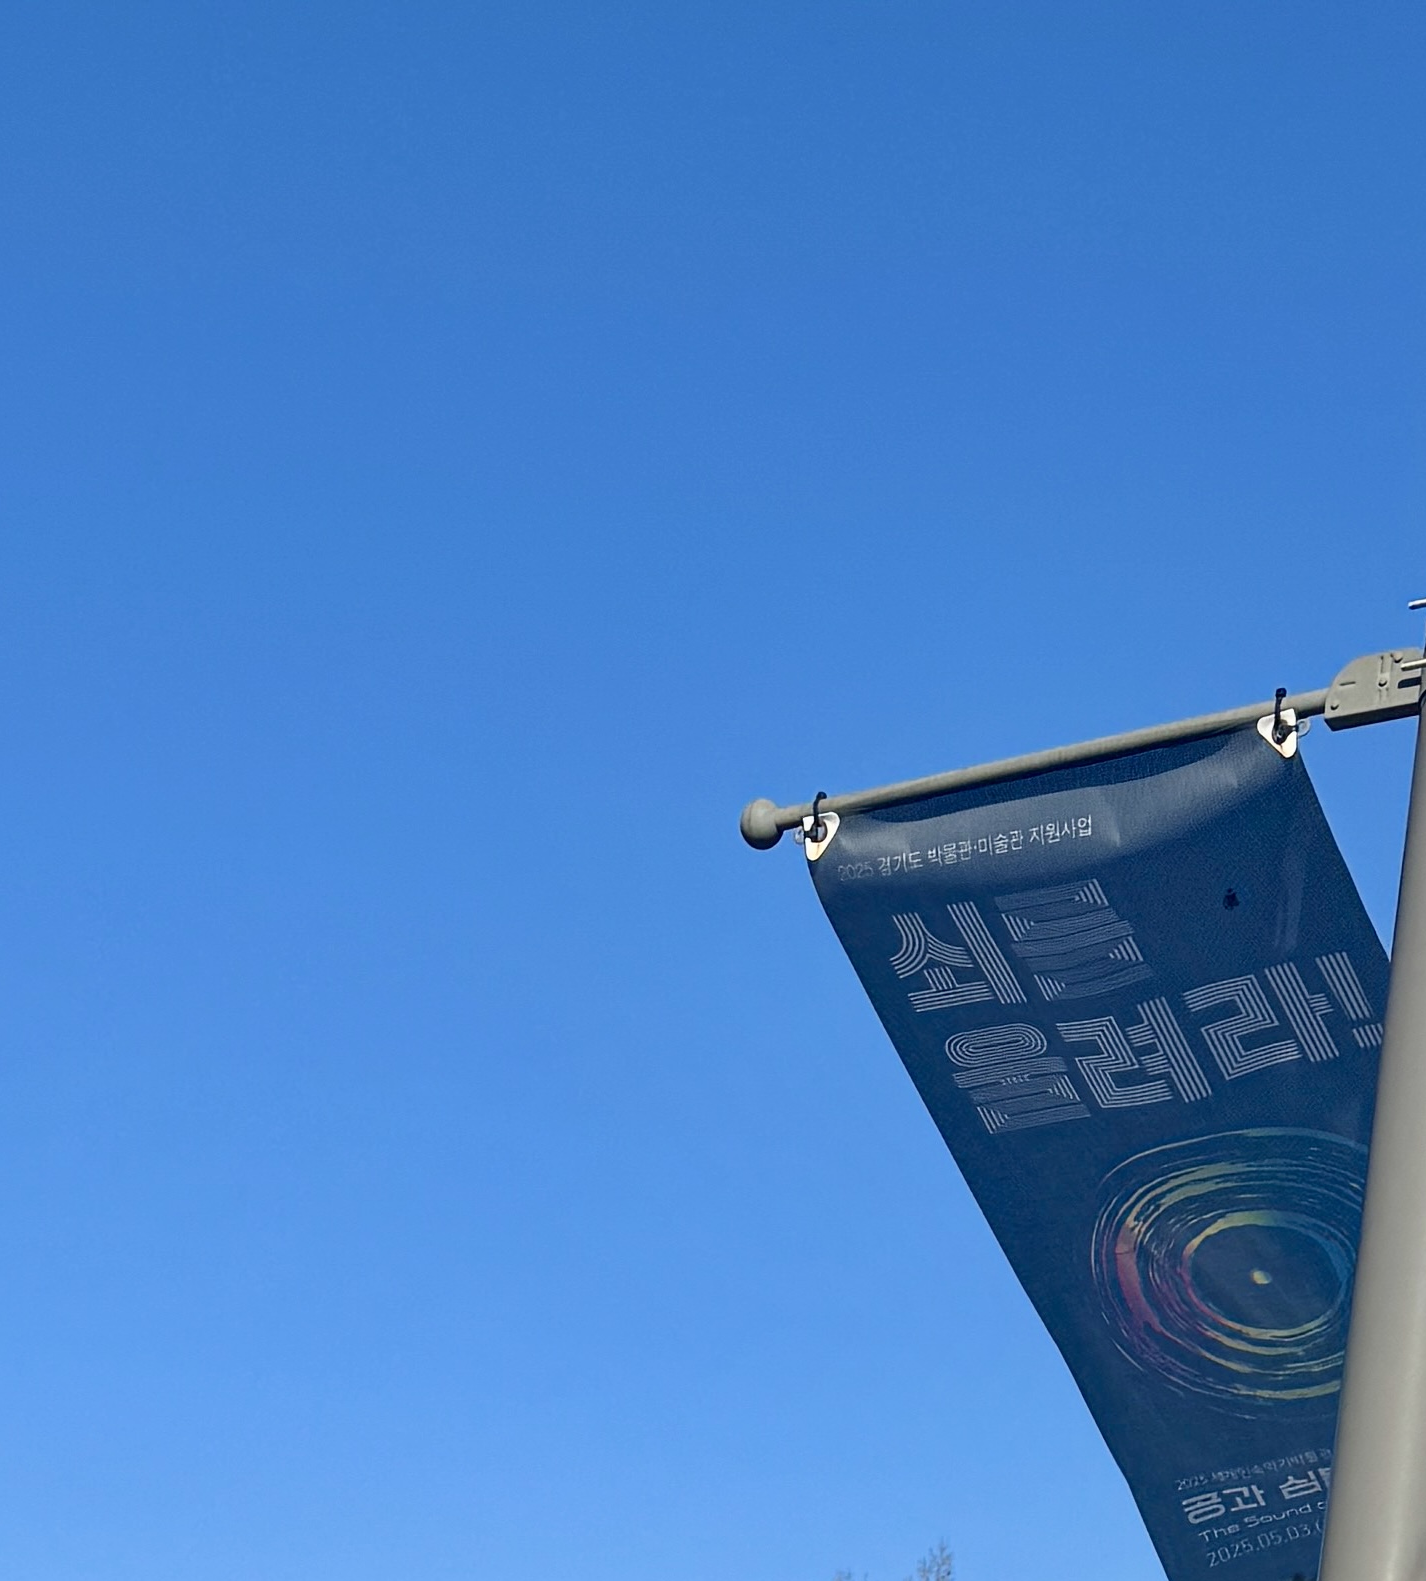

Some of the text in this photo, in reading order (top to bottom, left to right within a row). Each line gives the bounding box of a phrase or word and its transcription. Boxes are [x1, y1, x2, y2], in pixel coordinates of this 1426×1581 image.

[877, 850, 924, 877] 경기도
[1028, 814, 1093, 847] 지원사업
[944, 951, 1385, 1134] 울려라!
[1198, 1524, 1240, 1542] The
[1243, 1503, 1312, 1528] Sound
